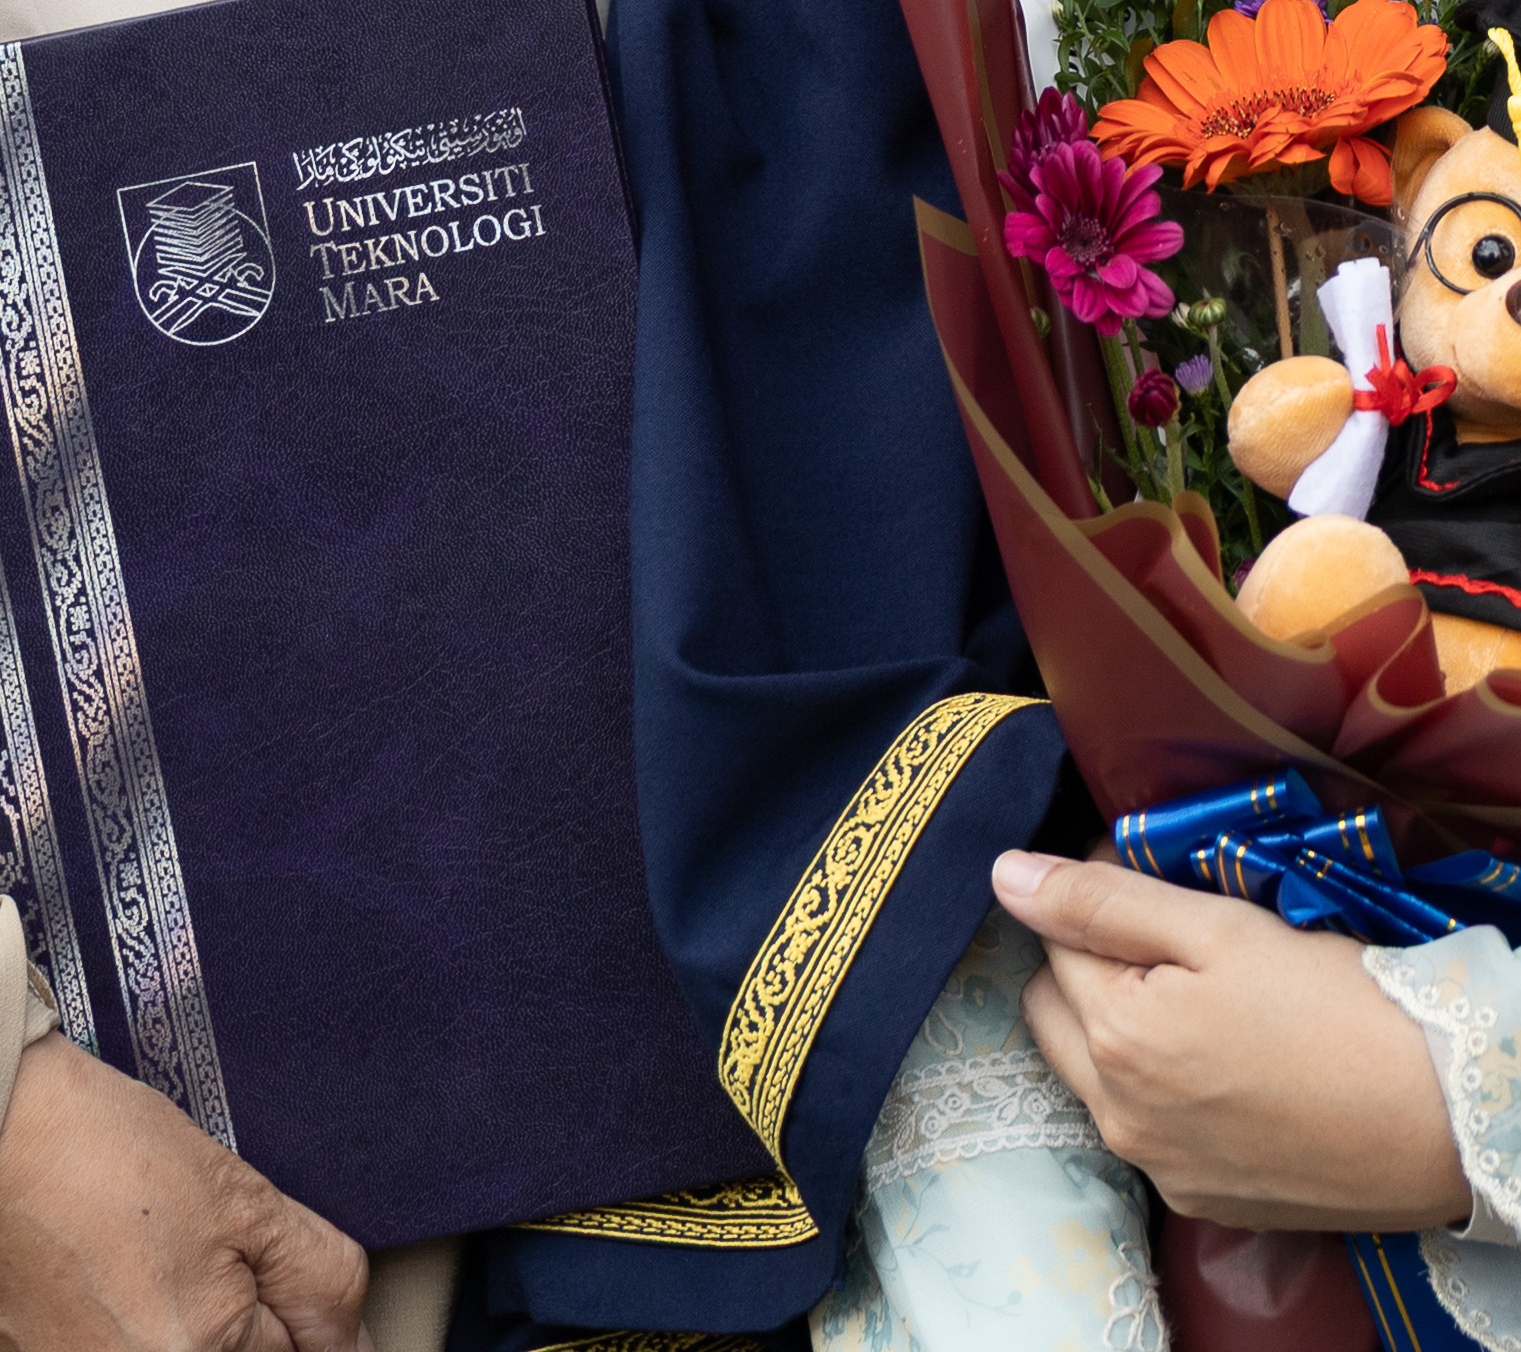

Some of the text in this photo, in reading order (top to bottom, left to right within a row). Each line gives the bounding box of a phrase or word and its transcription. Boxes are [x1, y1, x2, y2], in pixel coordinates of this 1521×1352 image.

[303, 163, 535, 238] UNIVERSITI
[310, 204, 548, 281] TEKNOLOGI
[318, 271, 441, 323] MARA
